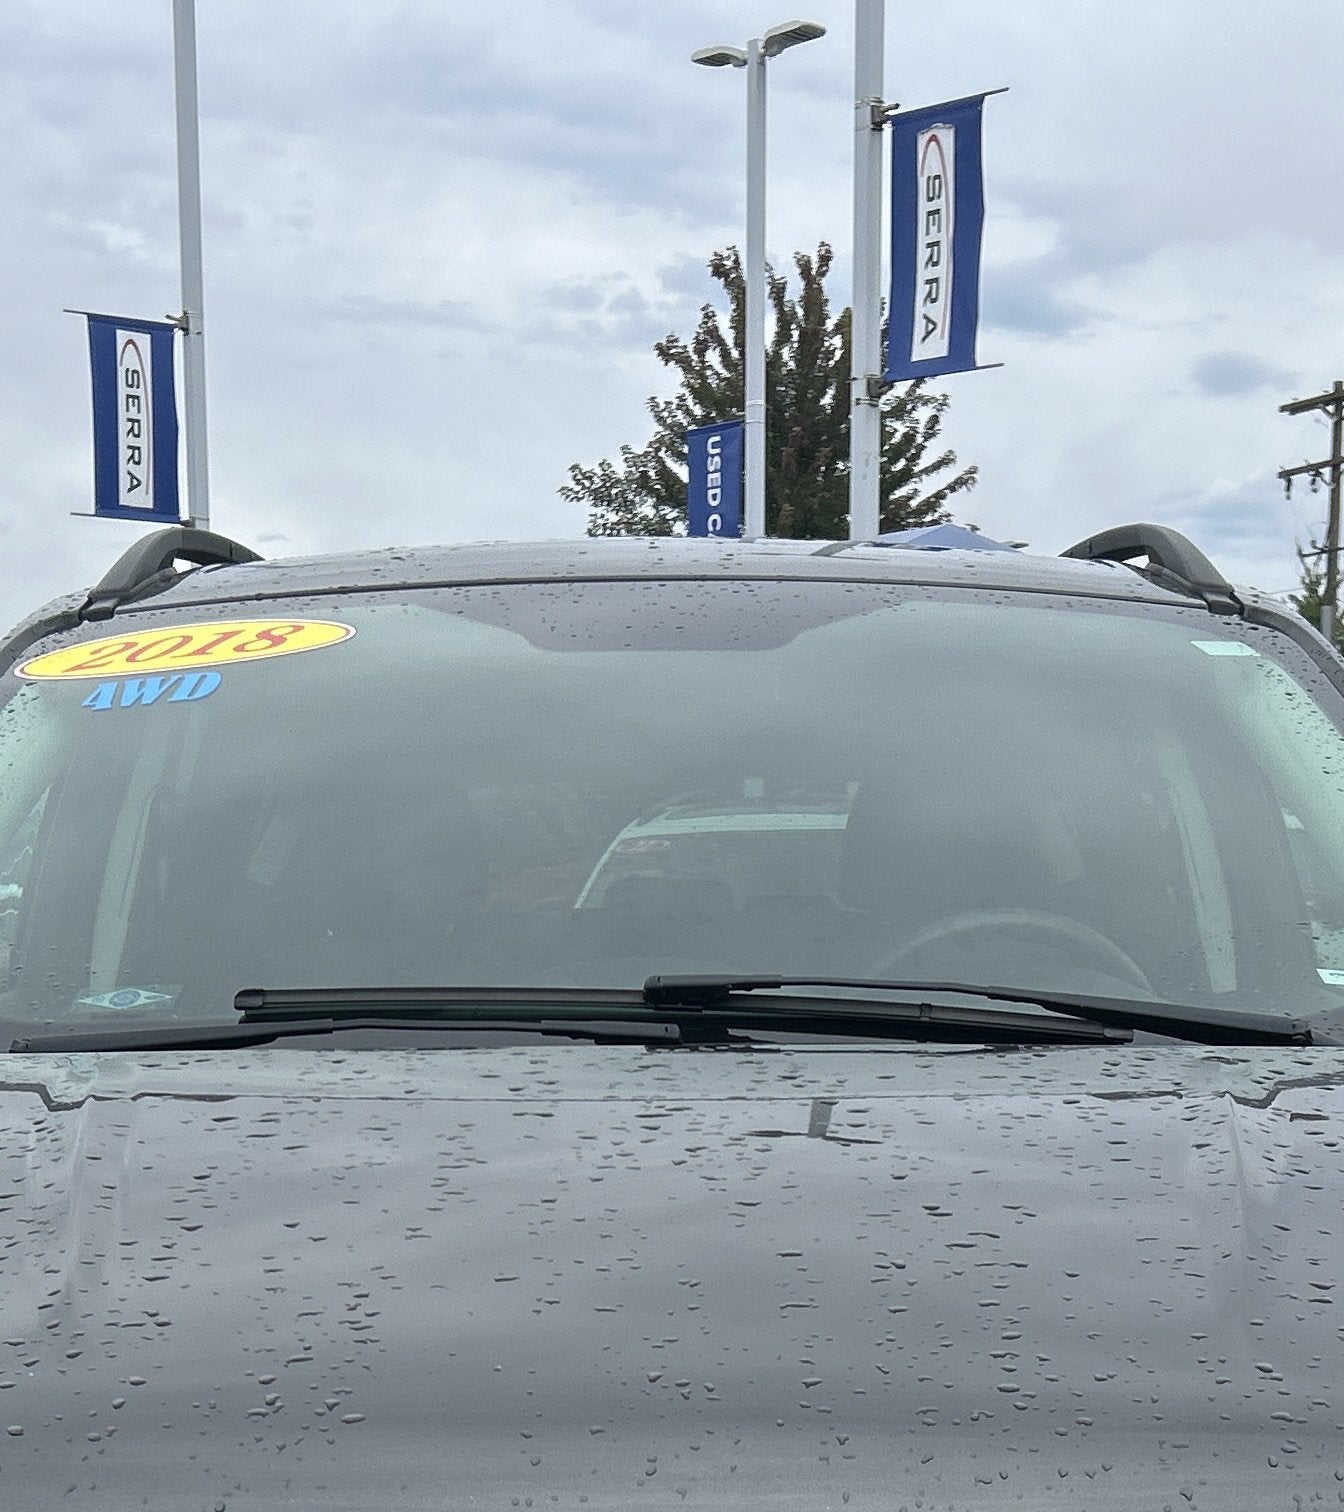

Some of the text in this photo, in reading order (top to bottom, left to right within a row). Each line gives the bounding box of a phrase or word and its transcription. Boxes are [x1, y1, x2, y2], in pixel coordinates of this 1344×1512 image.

[920, 174, 943, 345] SERRA
[125, 367, 142, 494] SERRA
[707, 435, 722, 538] USED C
[61, 624, 306, 673] 2018
[81, 671, 223, 711] 4WD
